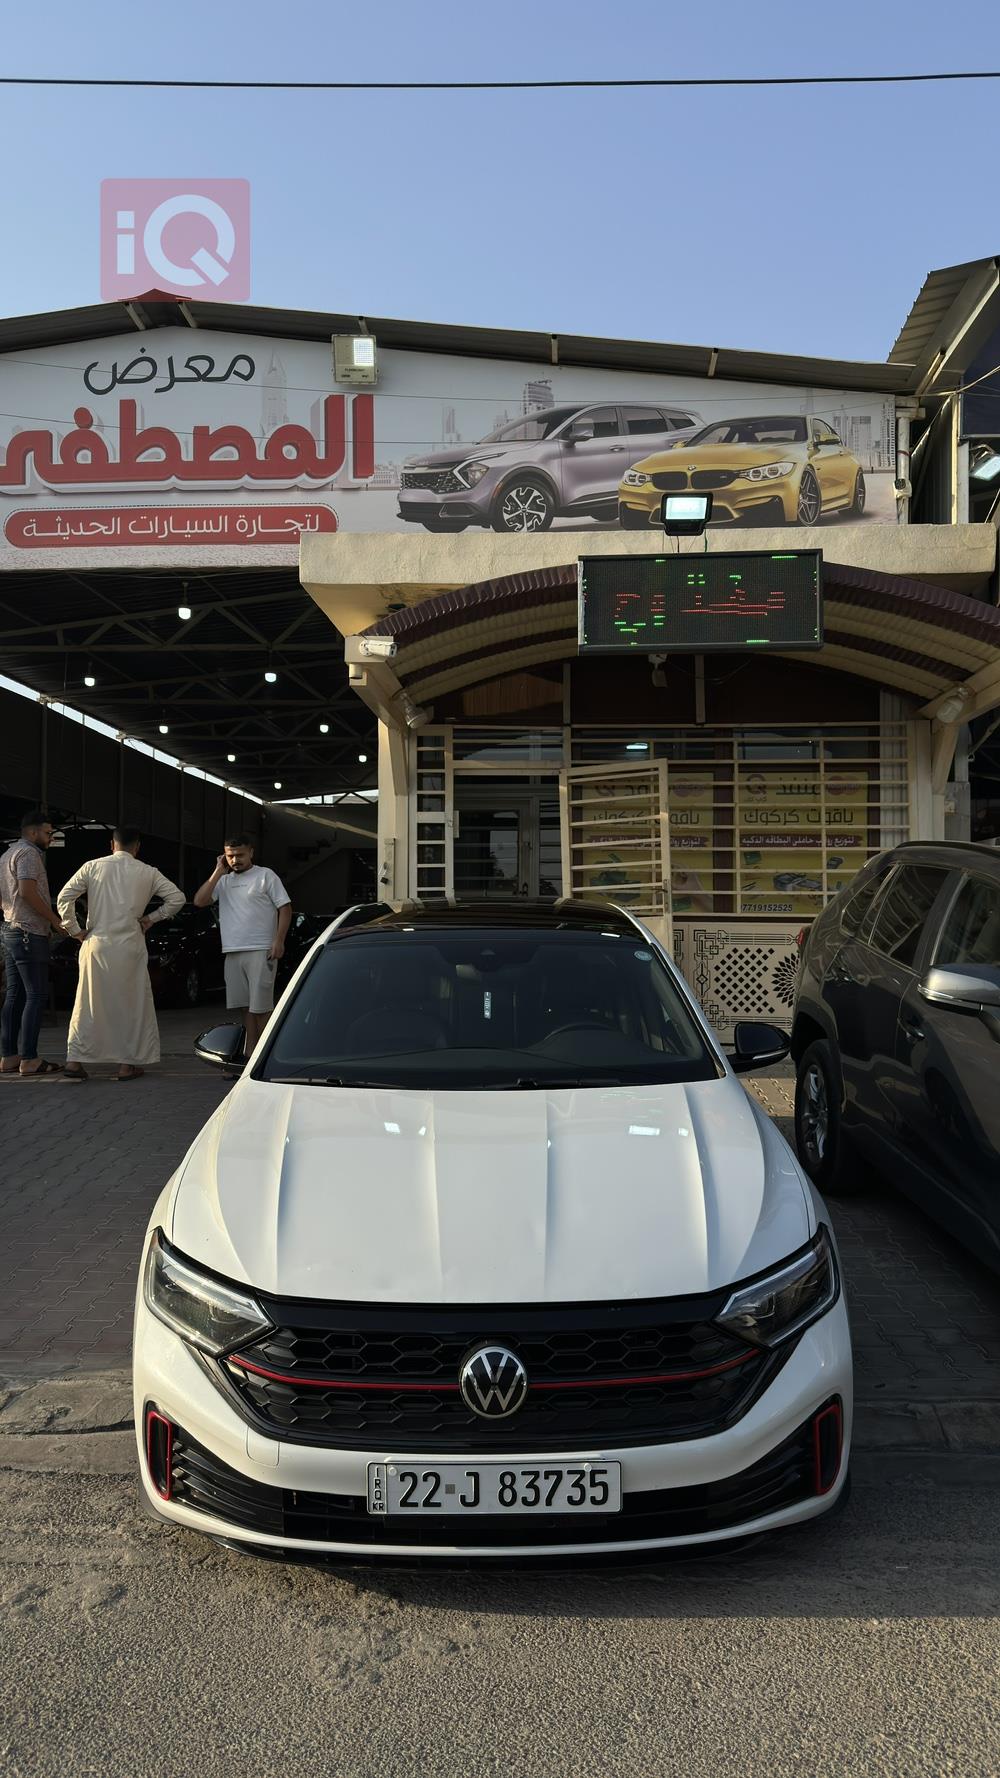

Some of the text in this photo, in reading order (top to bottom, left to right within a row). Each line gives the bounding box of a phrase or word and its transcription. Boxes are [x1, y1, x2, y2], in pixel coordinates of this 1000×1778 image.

[84, 347, 256, 395] معرض
[0, 393, 375, 488] المصطفى
[23, 513, 320, 539] لتجارة السيارات الحديثة
[744, 808, 800, 825] كركوك
[740, 903, 793, 912] 7719152525
[399, 1469, 609, 1508] 22 J 83735
[373, 1502, 384, 1512] KR
